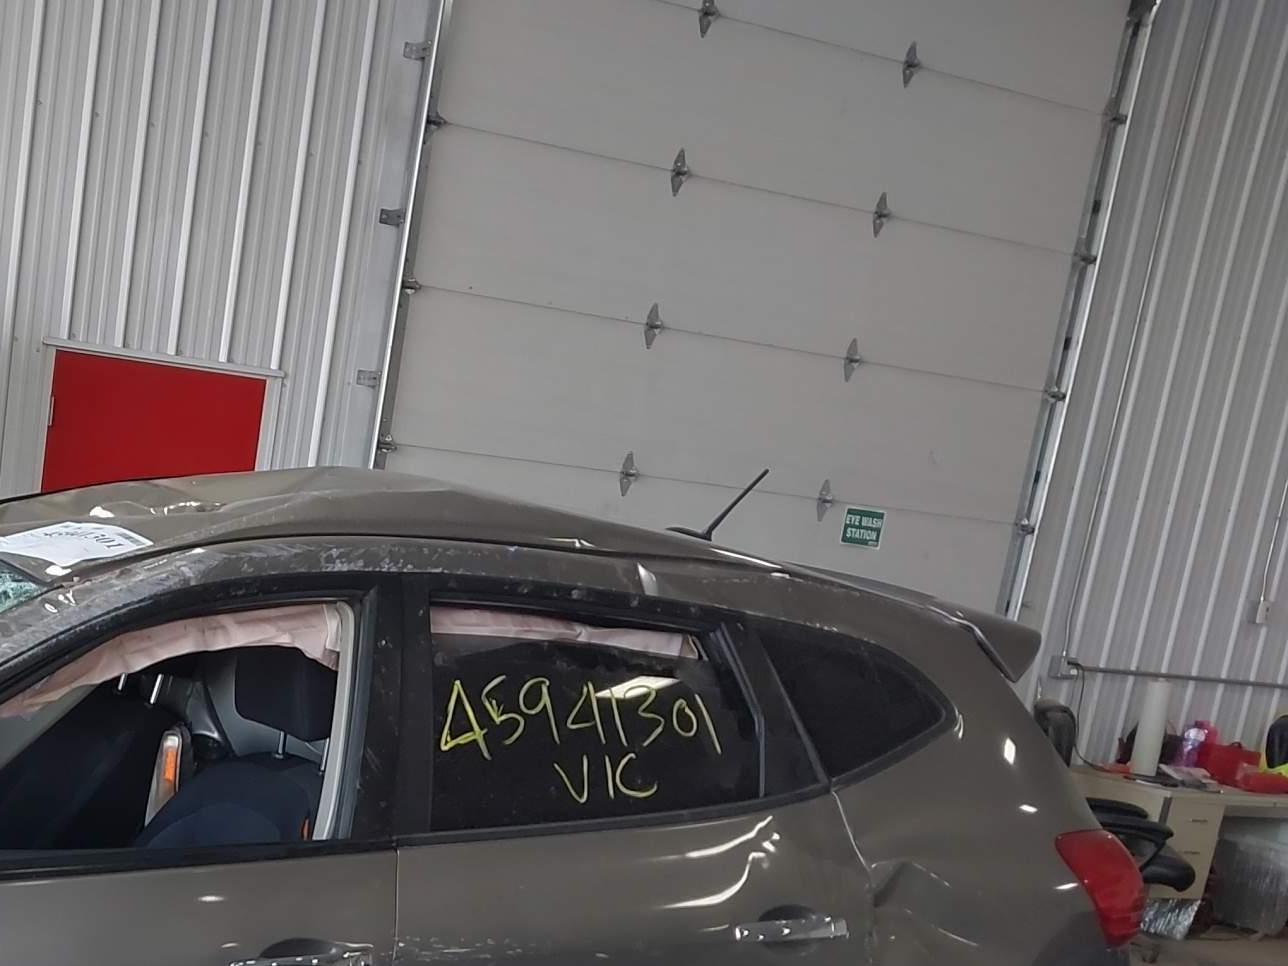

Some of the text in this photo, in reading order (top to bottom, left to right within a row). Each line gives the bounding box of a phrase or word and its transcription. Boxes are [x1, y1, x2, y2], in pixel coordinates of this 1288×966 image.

[846, 514, 883, 528] EYE WASH
[846, 528, 877, 541] STATION
[440, 674, 722, 761] 45941301
[553, 752, 658, 804] VIC
